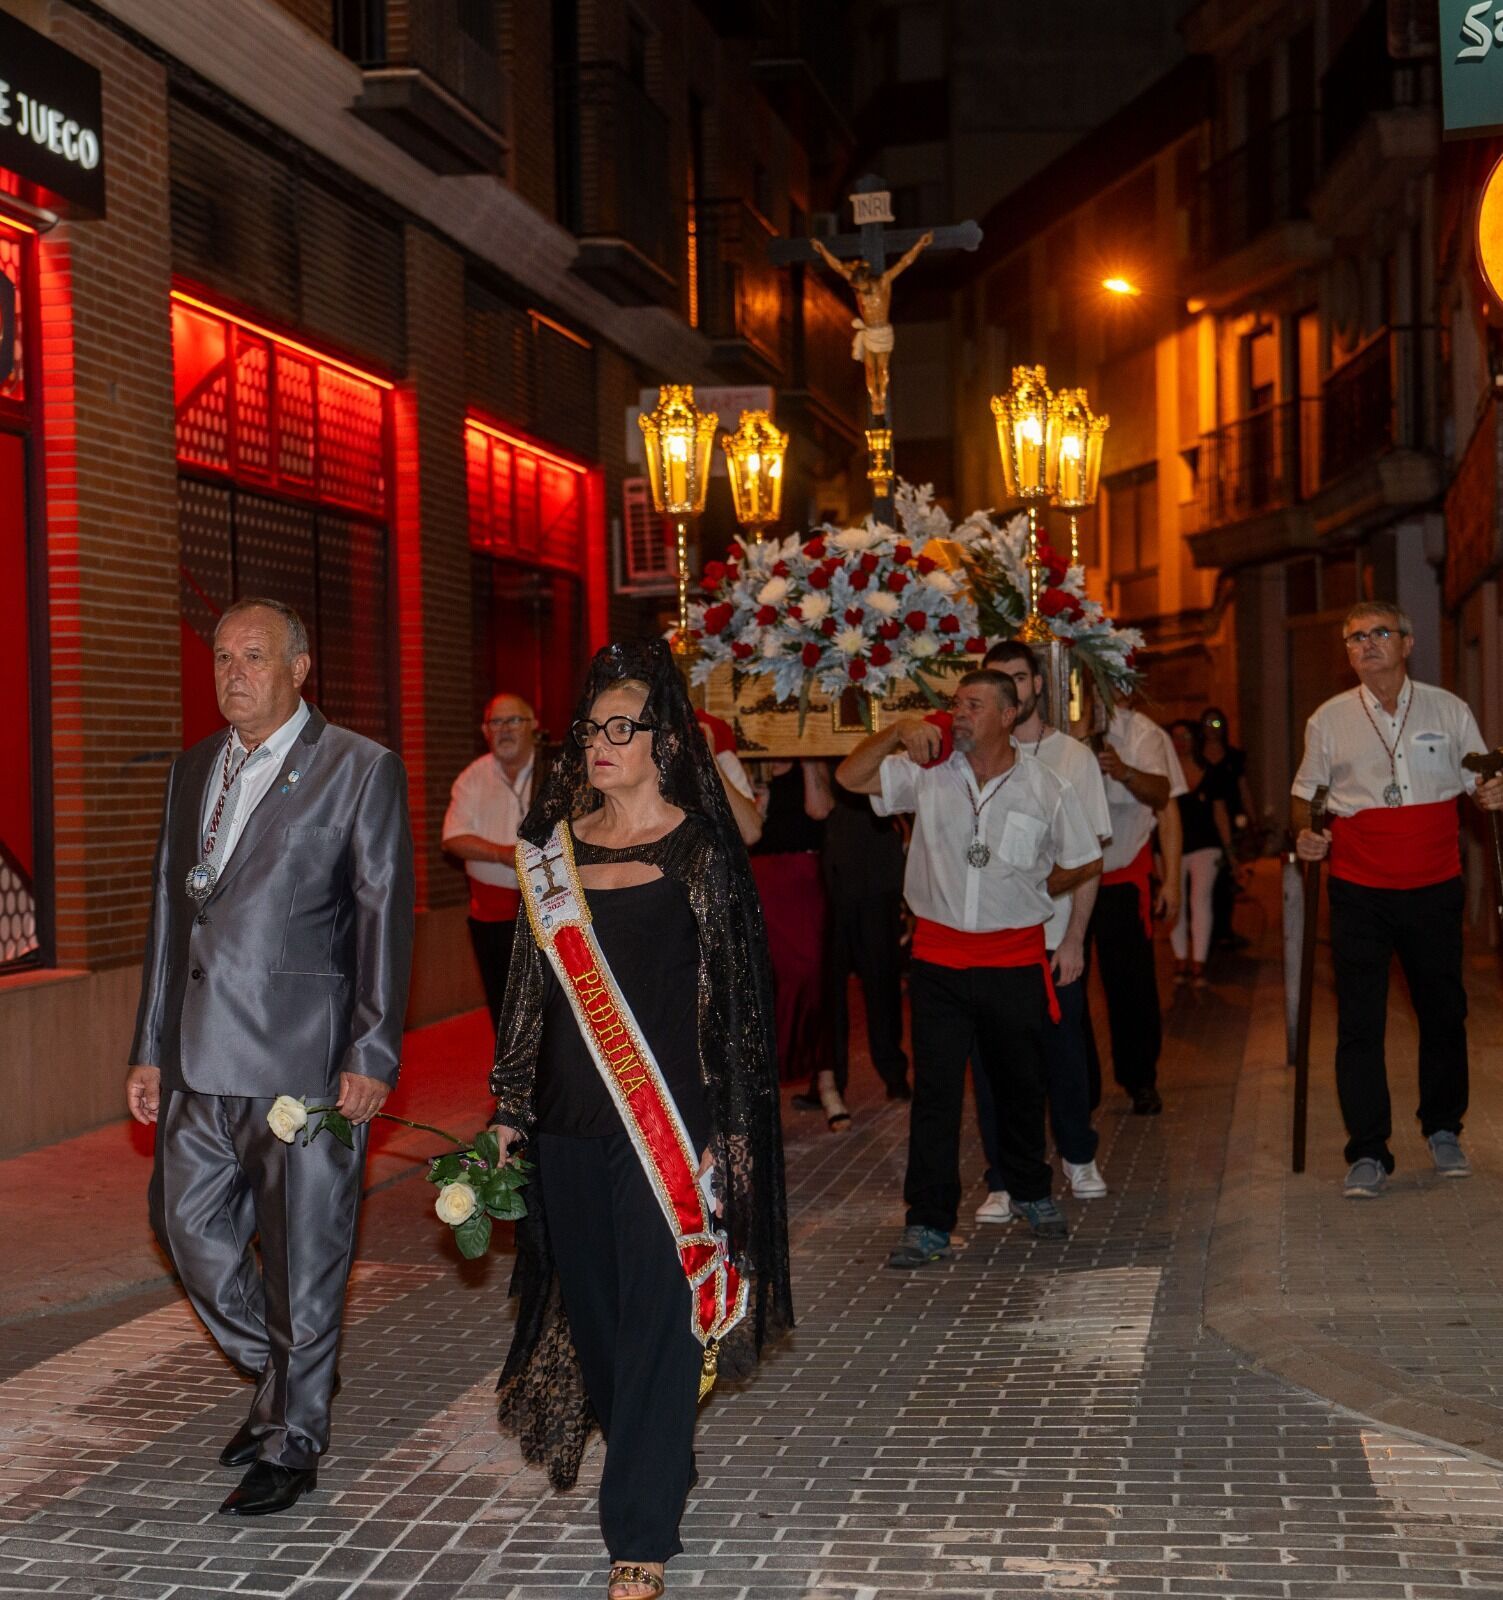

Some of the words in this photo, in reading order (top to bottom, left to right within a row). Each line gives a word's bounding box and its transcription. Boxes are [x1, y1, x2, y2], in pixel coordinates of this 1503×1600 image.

[16, 91, 100, 170] JUEGO
[857, 196, 890, 219] INRI
[572, 968, 649, 1098] PADRINA
